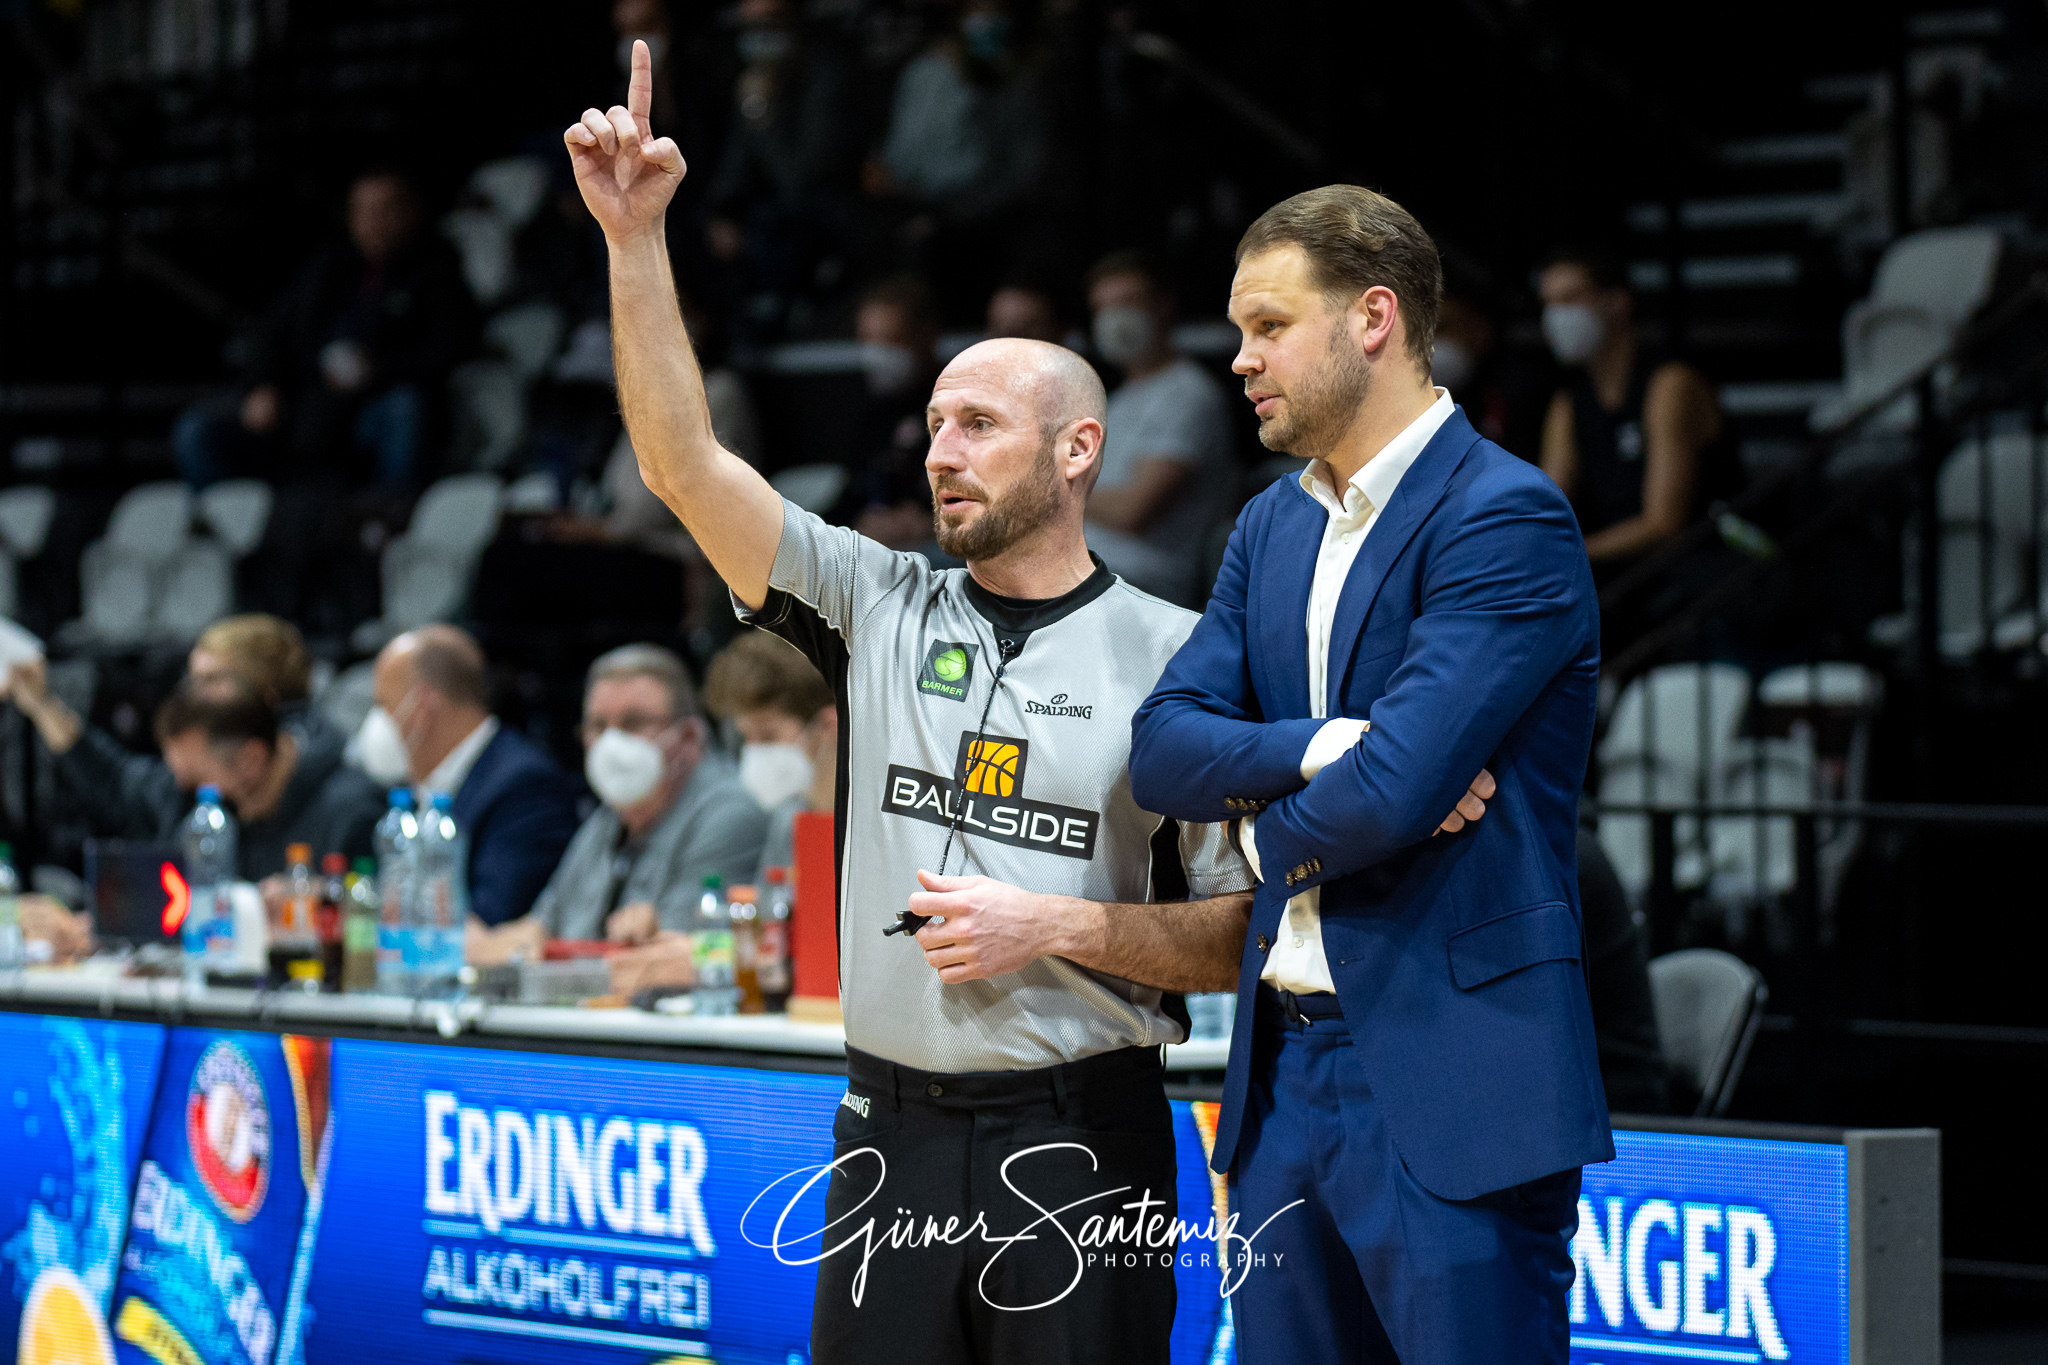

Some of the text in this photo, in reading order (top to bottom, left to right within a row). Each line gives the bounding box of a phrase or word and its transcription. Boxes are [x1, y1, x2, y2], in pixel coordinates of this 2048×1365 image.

[921, 680, 964, 697] BARMER
[1025, 700, 1092, 719] SPALDING
[892, 776, 1089, 849] BALLSIDE
[423, 1089, 717, 1257] ERDINGER
[422, 1245, 711, 1330] ALKOHOLFREI
